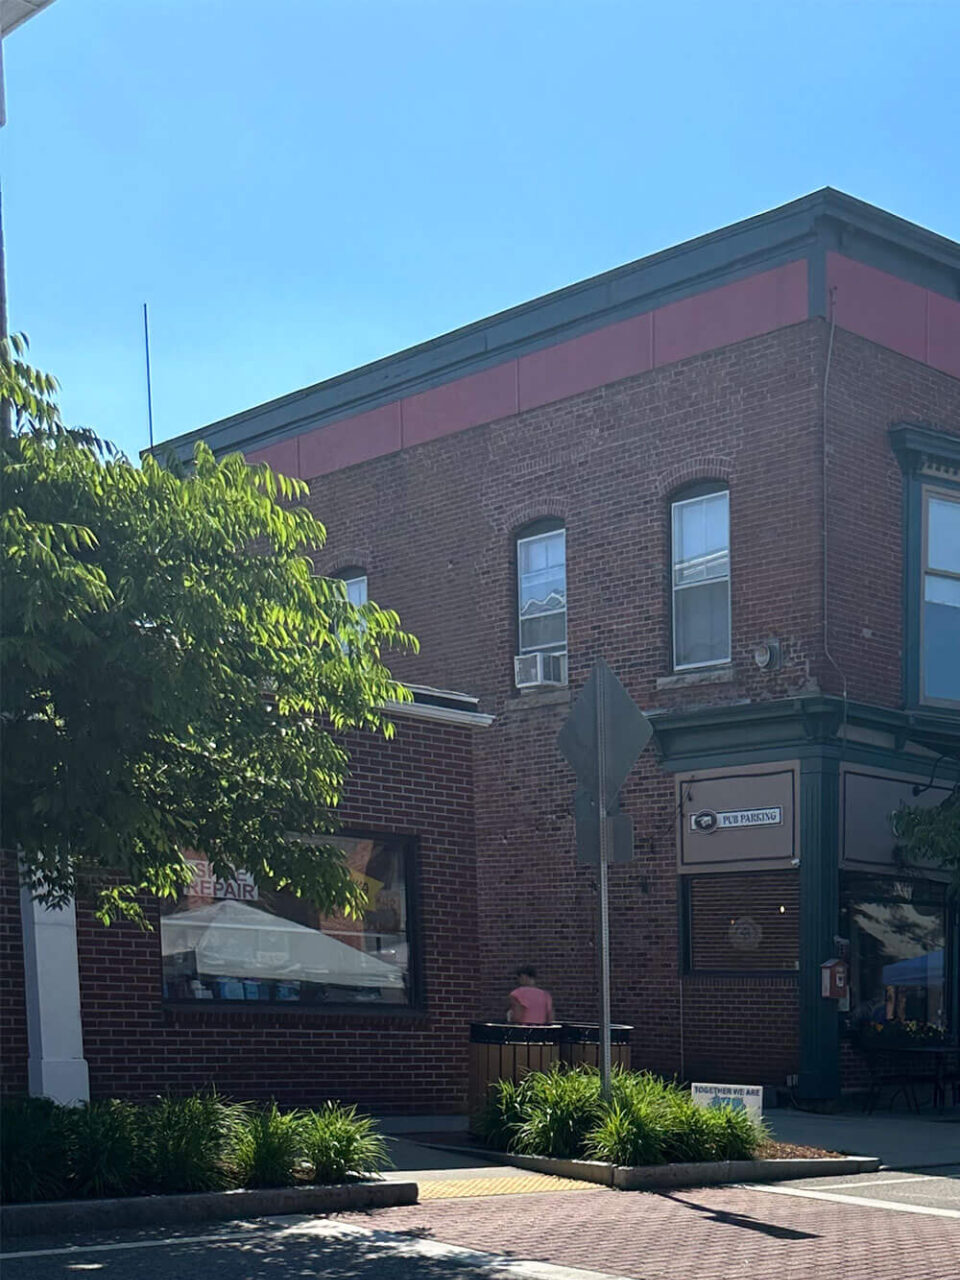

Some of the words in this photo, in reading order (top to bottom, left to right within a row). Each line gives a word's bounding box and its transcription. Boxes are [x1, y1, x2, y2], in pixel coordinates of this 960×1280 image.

[723, 813, 739, 825] PUB
[740, 811, 777, 824] PARKING
[186, 880, 255, 899] REPAIR
[694, 1085, 732, 1095] TOGETHER
[733, 1088, 745, 1096] WE
[745, 1088, 760, 1096] ARE
